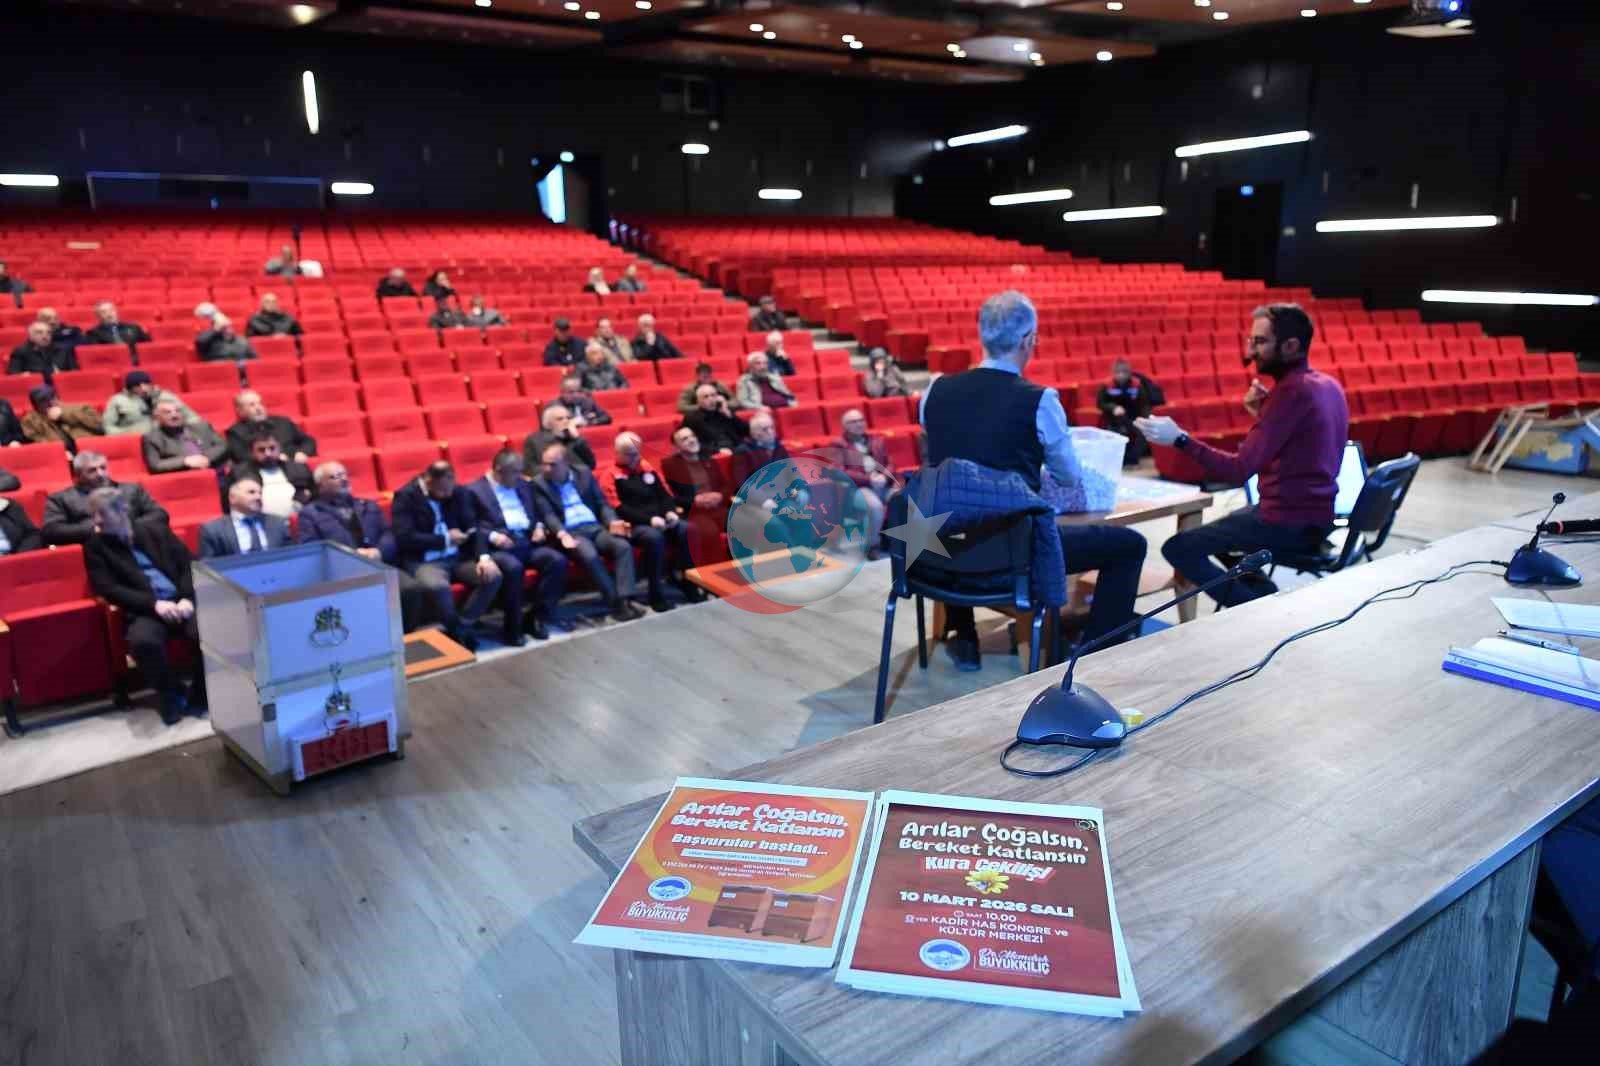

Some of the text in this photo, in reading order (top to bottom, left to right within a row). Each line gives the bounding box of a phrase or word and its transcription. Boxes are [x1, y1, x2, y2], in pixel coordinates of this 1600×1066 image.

[680, 802, 849, 827] Arılar Çoğalsın,
[671, 815, 844, 838] Bereket Katlansın
[902, 822, 1089, 851] Arılar Çoğalsın,
[671, 833, 755, 850] Başvurular
[899, 838, 1087, 865] Bereket Katlansın
[925, 856, 970, 871] Kura
[900, 891, 1075, 918] 10 MART 2026 SALI
[931, 913, 969, 927] KADİR
[972, 919, 997, 930] HAS
[1000, 922, 1051, 935] KONGRE
[1054, 929, 1069, 937] ve
[985, 912, 1017, 923] 10.00
[939, 925, 1044, 944] KÜLTÜR MERKEZİ
